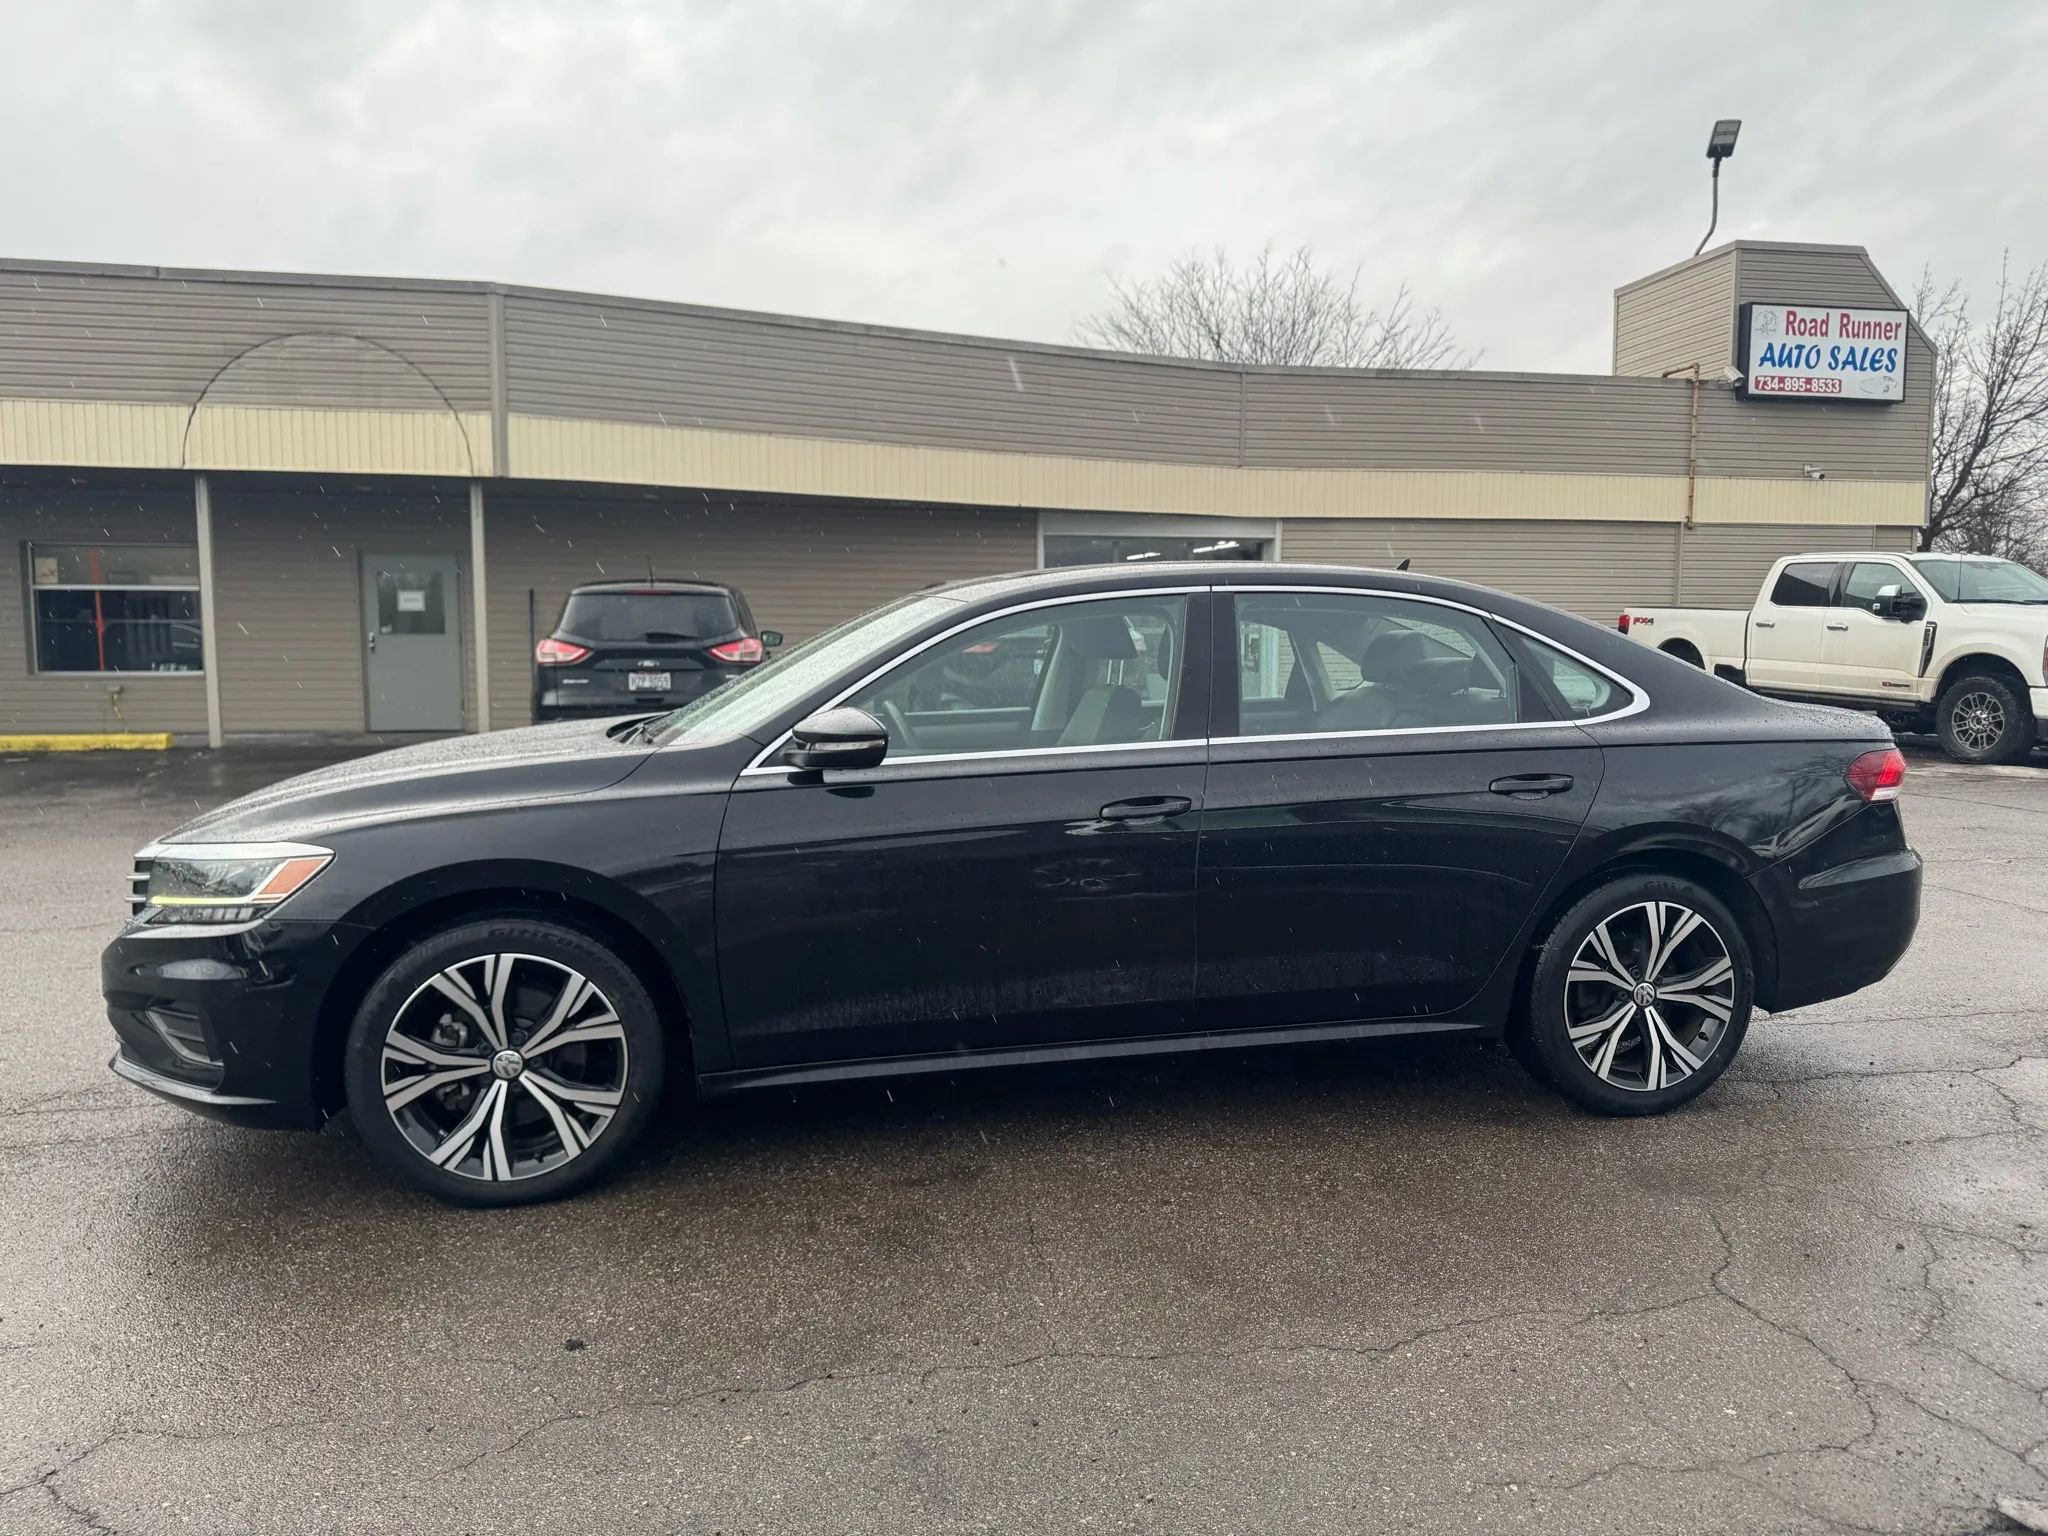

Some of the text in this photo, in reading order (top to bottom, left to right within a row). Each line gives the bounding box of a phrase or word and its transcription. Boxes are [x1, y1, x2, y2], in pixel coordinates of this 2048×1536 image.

[1785, 310, 1902, 341] Road Runner
[1758, 342, 1898, 373] AUTO SALES
[1756, 376, 1841, 393] 734-895-8533
[1633, 616, 1655, 626] FX4
